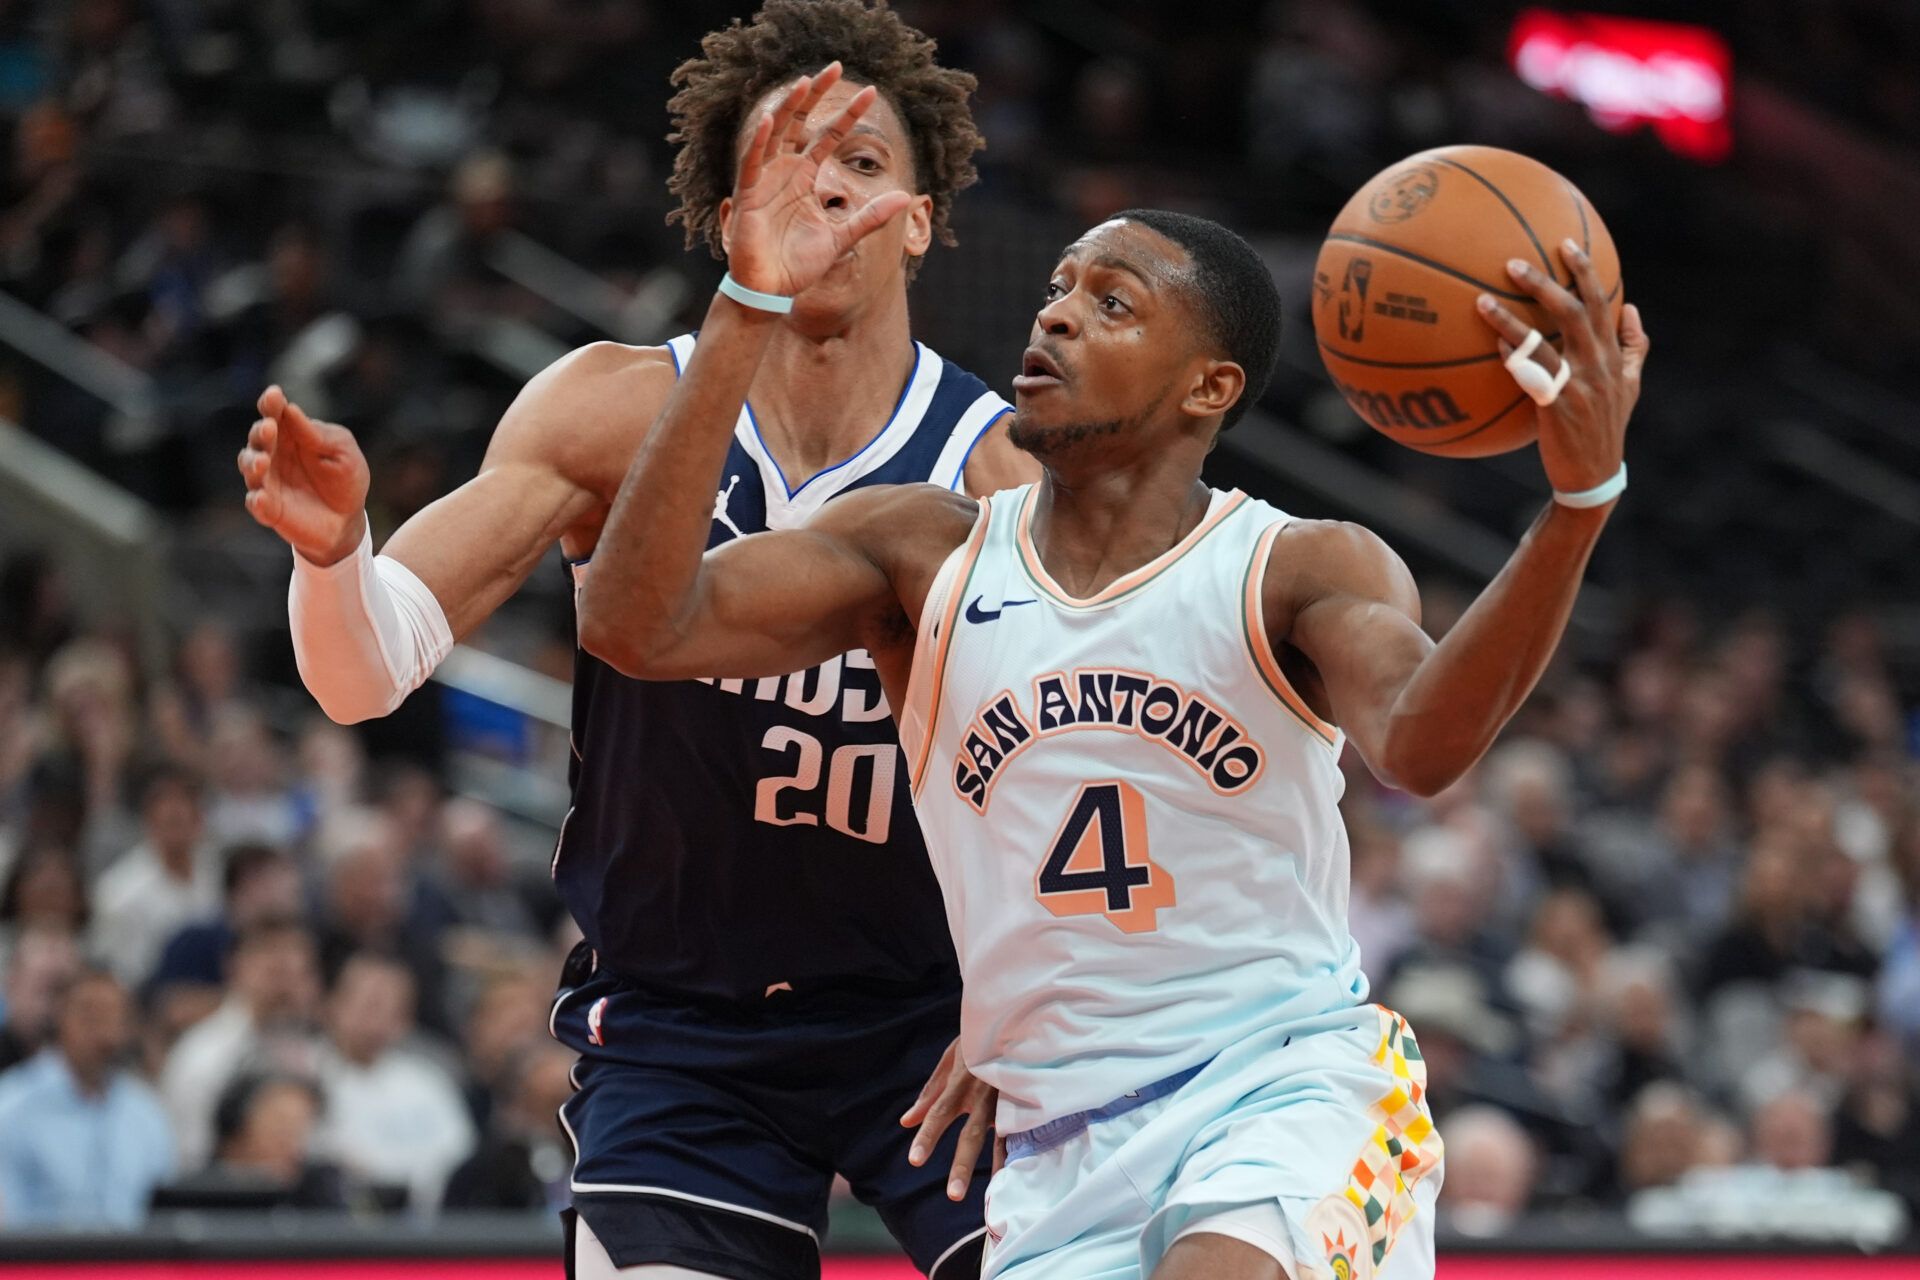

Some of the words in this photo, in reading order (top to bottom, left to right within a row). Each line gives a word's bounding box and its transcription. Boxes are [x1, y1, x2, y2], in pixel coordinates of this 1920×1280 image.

[754, 725, 898, 844] 20
[954, 692, 1034, 812] SAN
[1035, 669, 1263, 795] ANTONIO
[1036, 781, 1163, 922] 4
